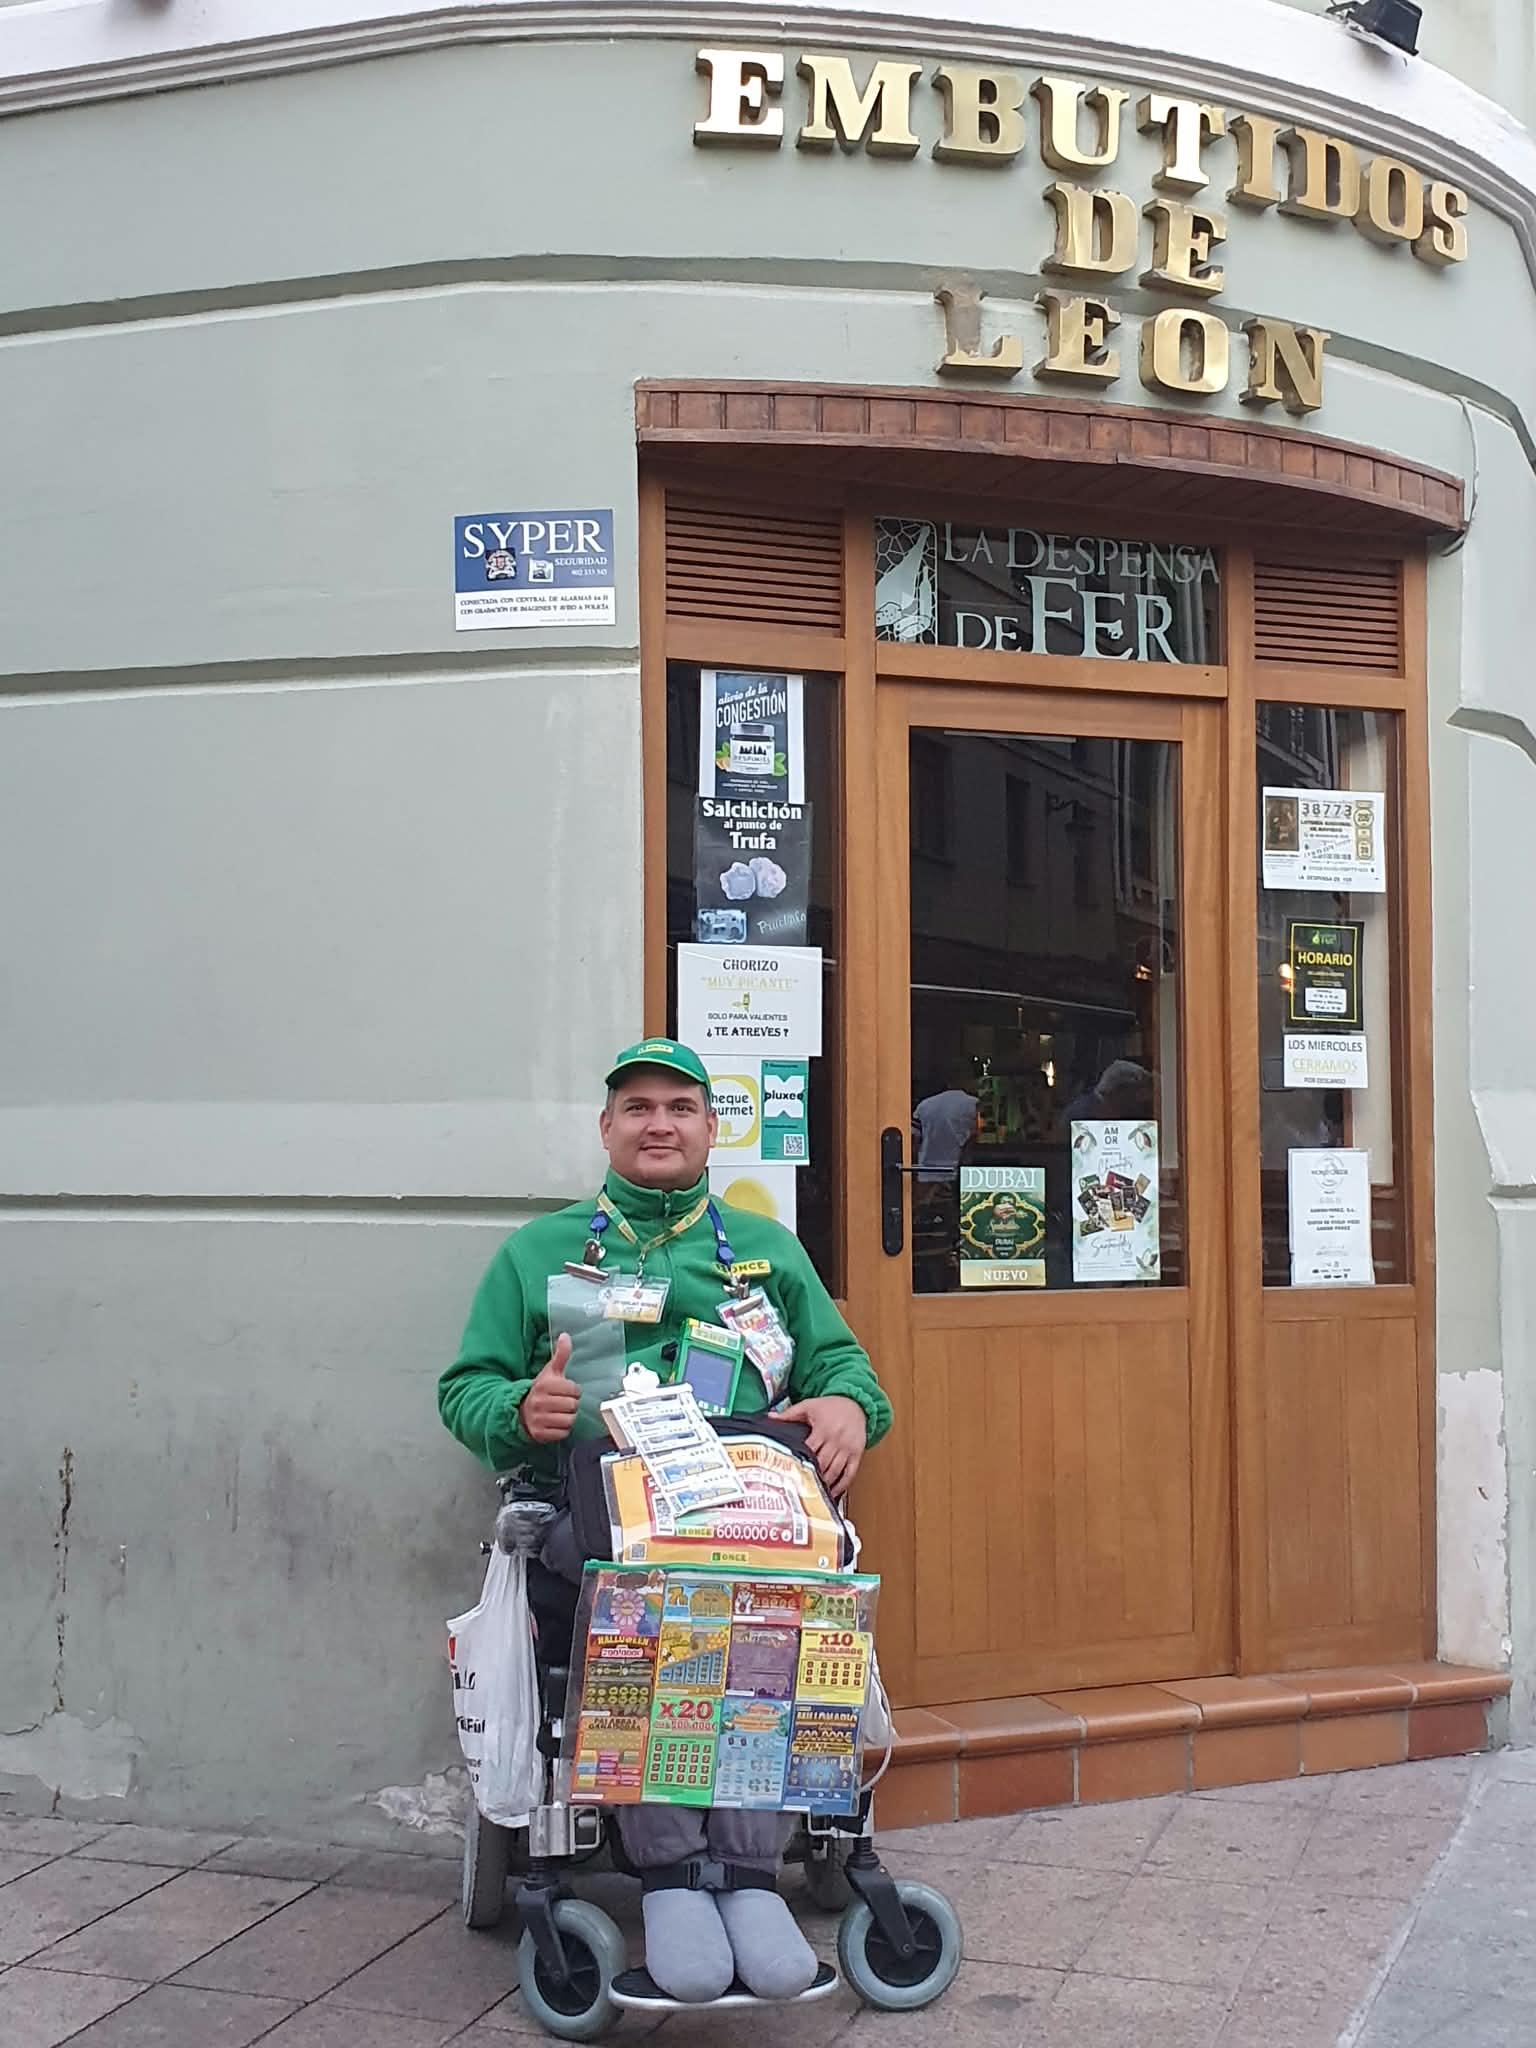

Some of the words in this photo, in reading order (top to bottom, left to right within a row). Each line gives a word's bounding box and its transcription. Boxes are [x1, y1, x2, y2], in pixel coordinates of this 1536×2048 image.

[695, 49, 1468, 267] EMBUTIDOS
[1040, 182, 1226, 297] DE
[934, 285, 1331, 413] LEON
[463, 519, 606, 558] SYPER
[555, 557, 607, 567] SEGURIDAD
[945, 523, 994, 564] LA
[1006, 528, 1220, 585] DESPENSA
[956, 612, 1022, 652] DE
[1024, 575, 1182, 664] FER
[745, 686, 756, 698] de
[758, 682, 768, 694] la
[716, 690, 786, 728] CONGESTIÓN
[702, 799, 802, 820] Salchichón
[1302, 803, 1352, 817] 38773
[724, 820, 733, 829] al
[736, 820, 766, 832] punto
[769, 820, 782, 830] de
[730, 832, 776, 850] Trufa
[723, 959, 778, 972] CHORIZO
[1298, 952, 1353, 966] HORARIO
[1288, 1040, 1305, 1050] LOS
[1308, 1040, 1362, 1053] MIERCOLES
[712, 1093, 749, 1105] heque
[1104, 1127, 1118, 1135] AM
[1104, 1136, 1118, 1145] OR
[967, 1168, 1037, 1188] DUBAI
[983, 1270, 1028, 1281] NUEVO
[820, 1633, 853, 1646] x10
[660, 1700, 713, 1720] x20
